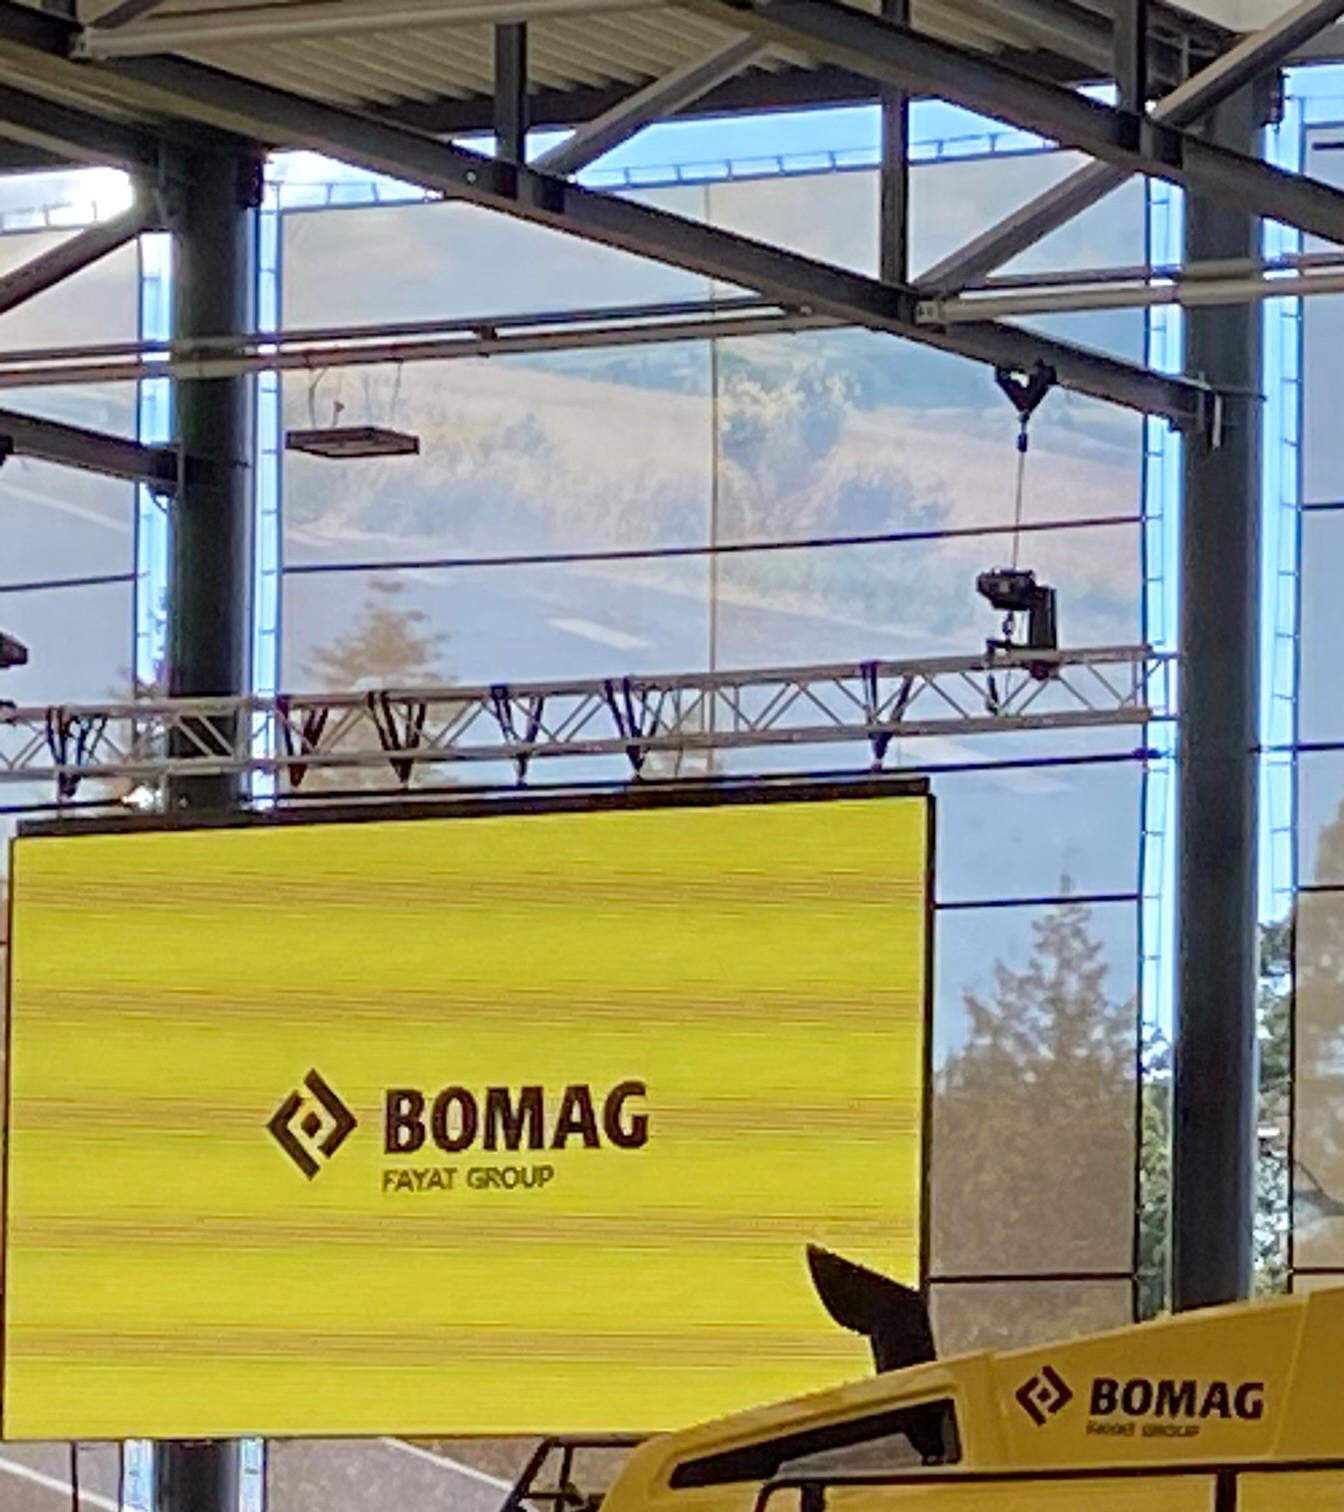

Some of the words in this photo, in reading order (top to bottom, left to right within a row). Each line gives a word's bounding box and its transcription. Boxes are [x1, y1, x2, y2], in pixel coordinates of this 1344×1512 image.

[384, 1080, 650, 1154] BOMAG
[382, 1166, 458, 1192] FAYAT
[466, 1164, 555, 1190] GROUP
[1089, 1377, 1265, 1421] BOMAG
